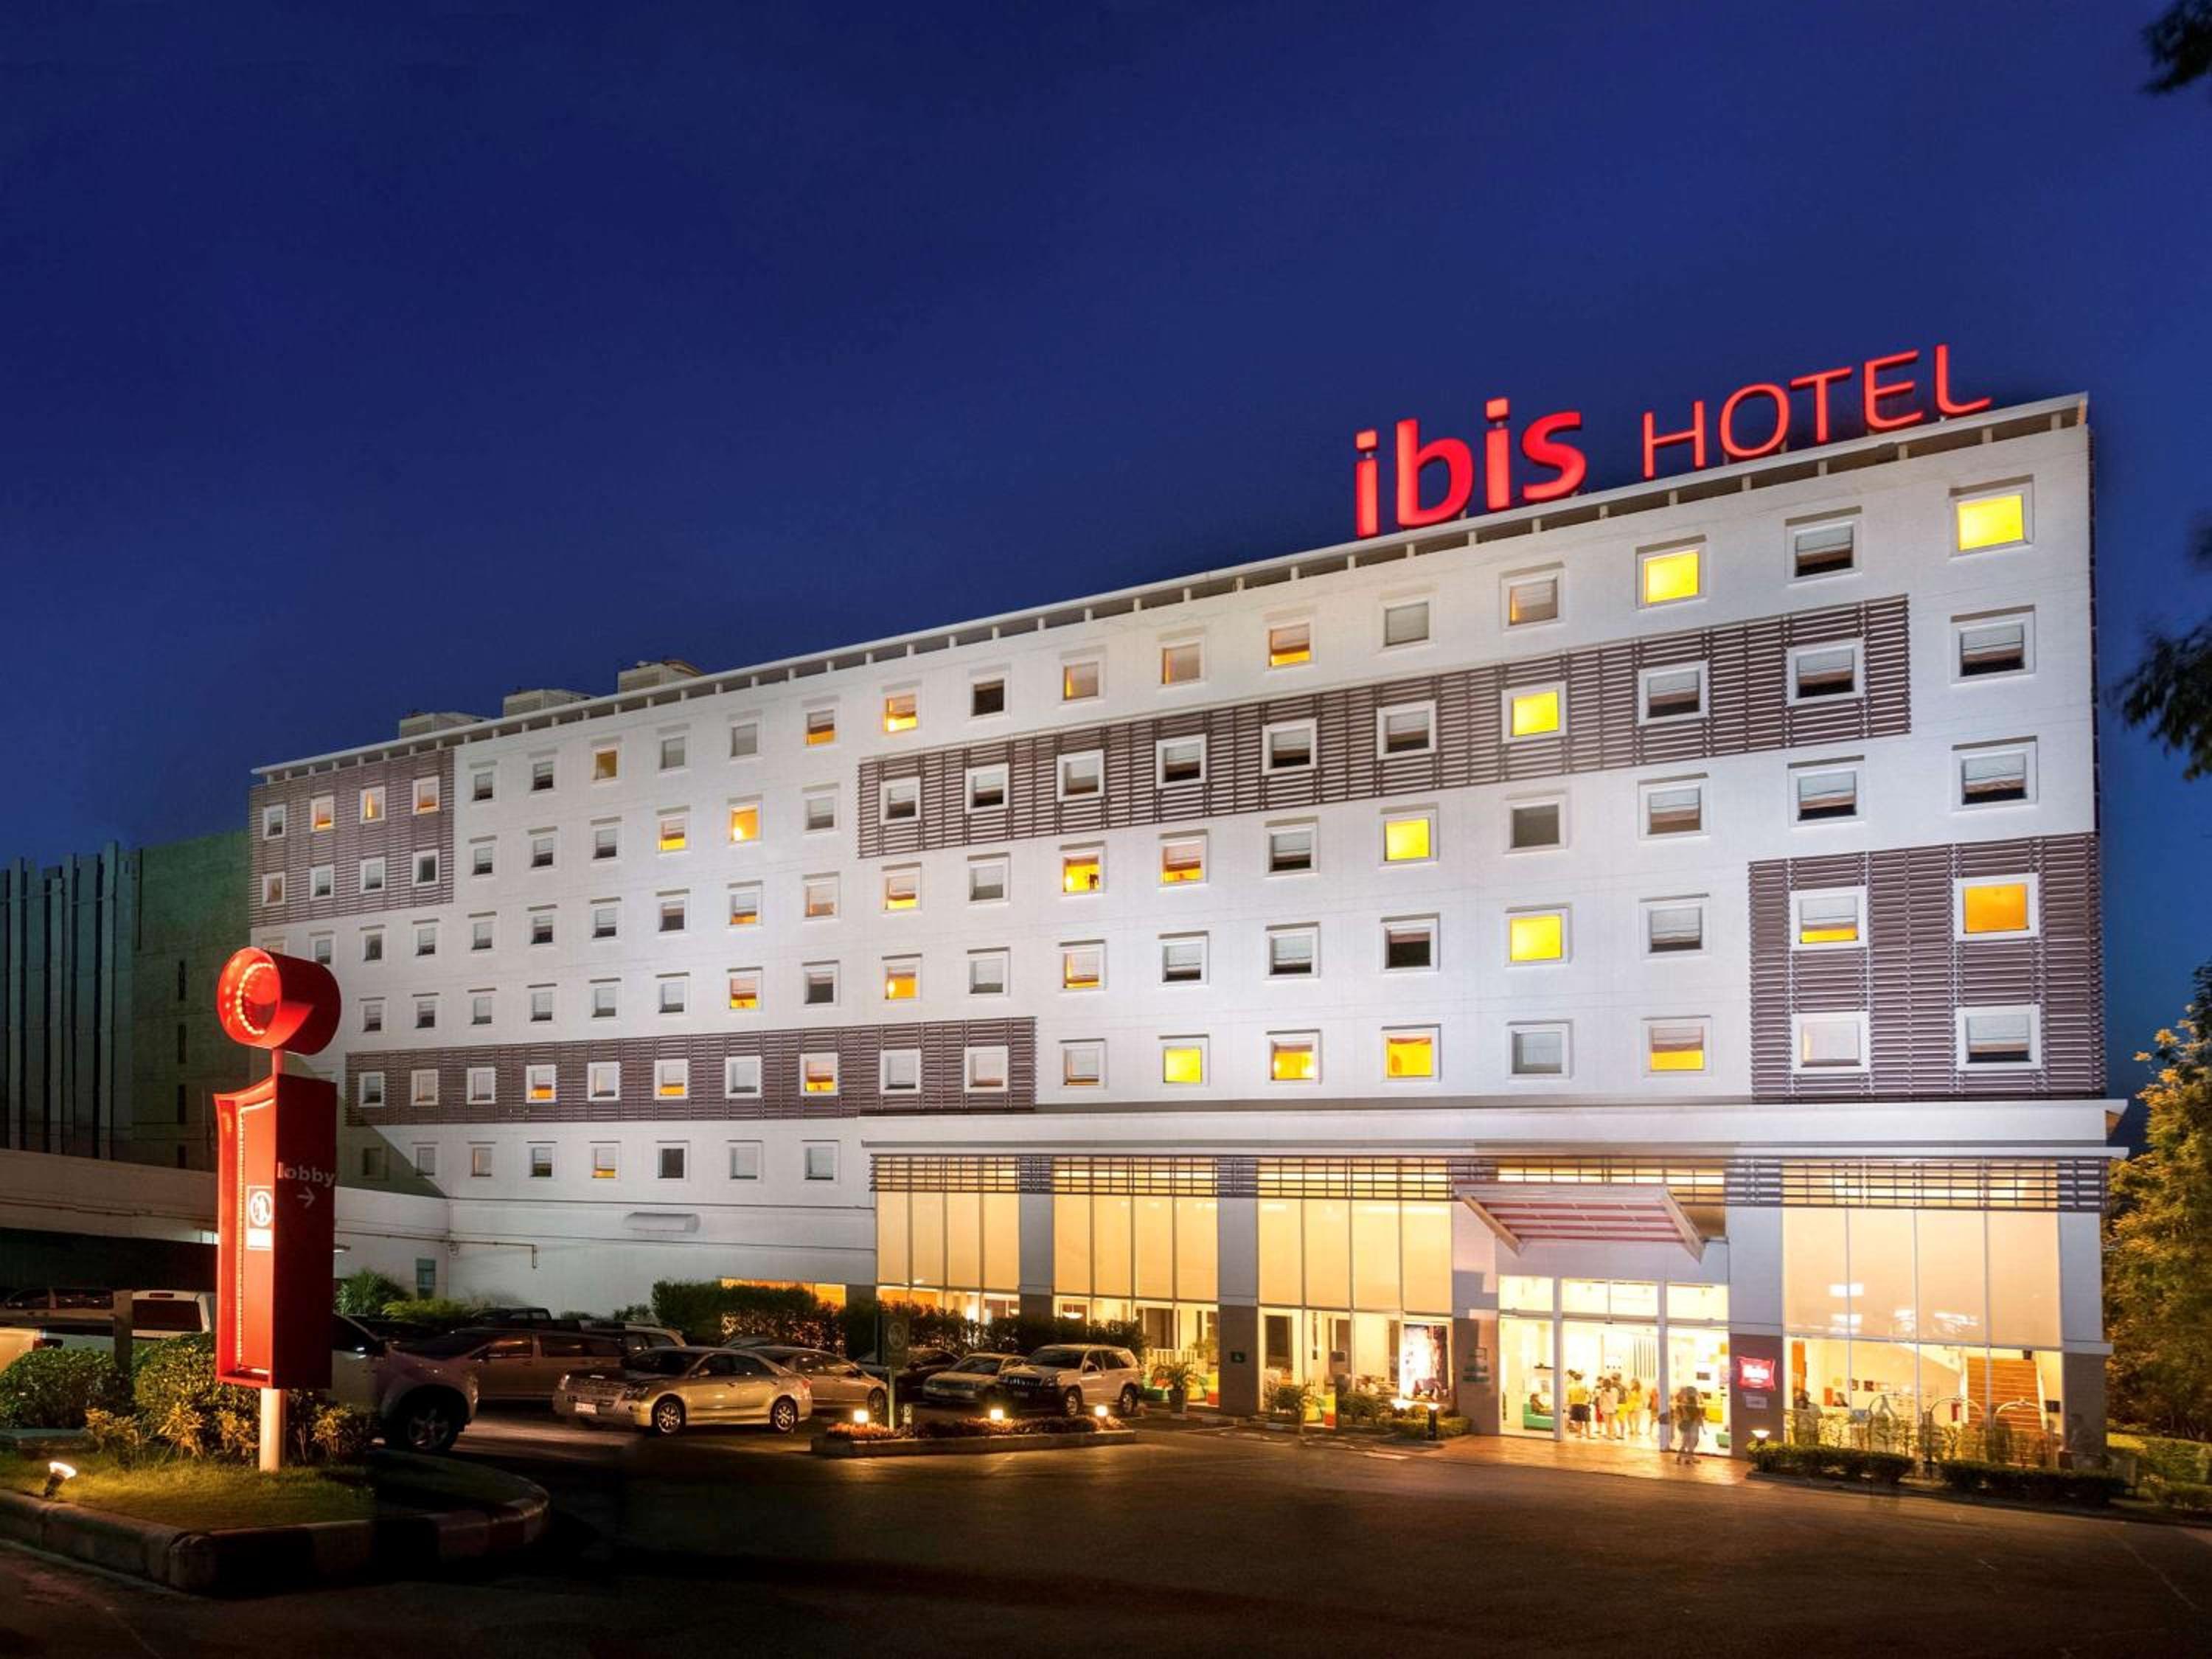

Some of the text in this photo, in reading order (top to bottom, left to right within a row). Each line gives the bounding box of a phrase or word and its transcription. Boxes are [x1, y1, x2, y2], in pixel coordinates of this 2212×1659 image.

[1355, 344, 1992, 538] ibis HOTEL
[277, 1161, 335, 1187] lobby
